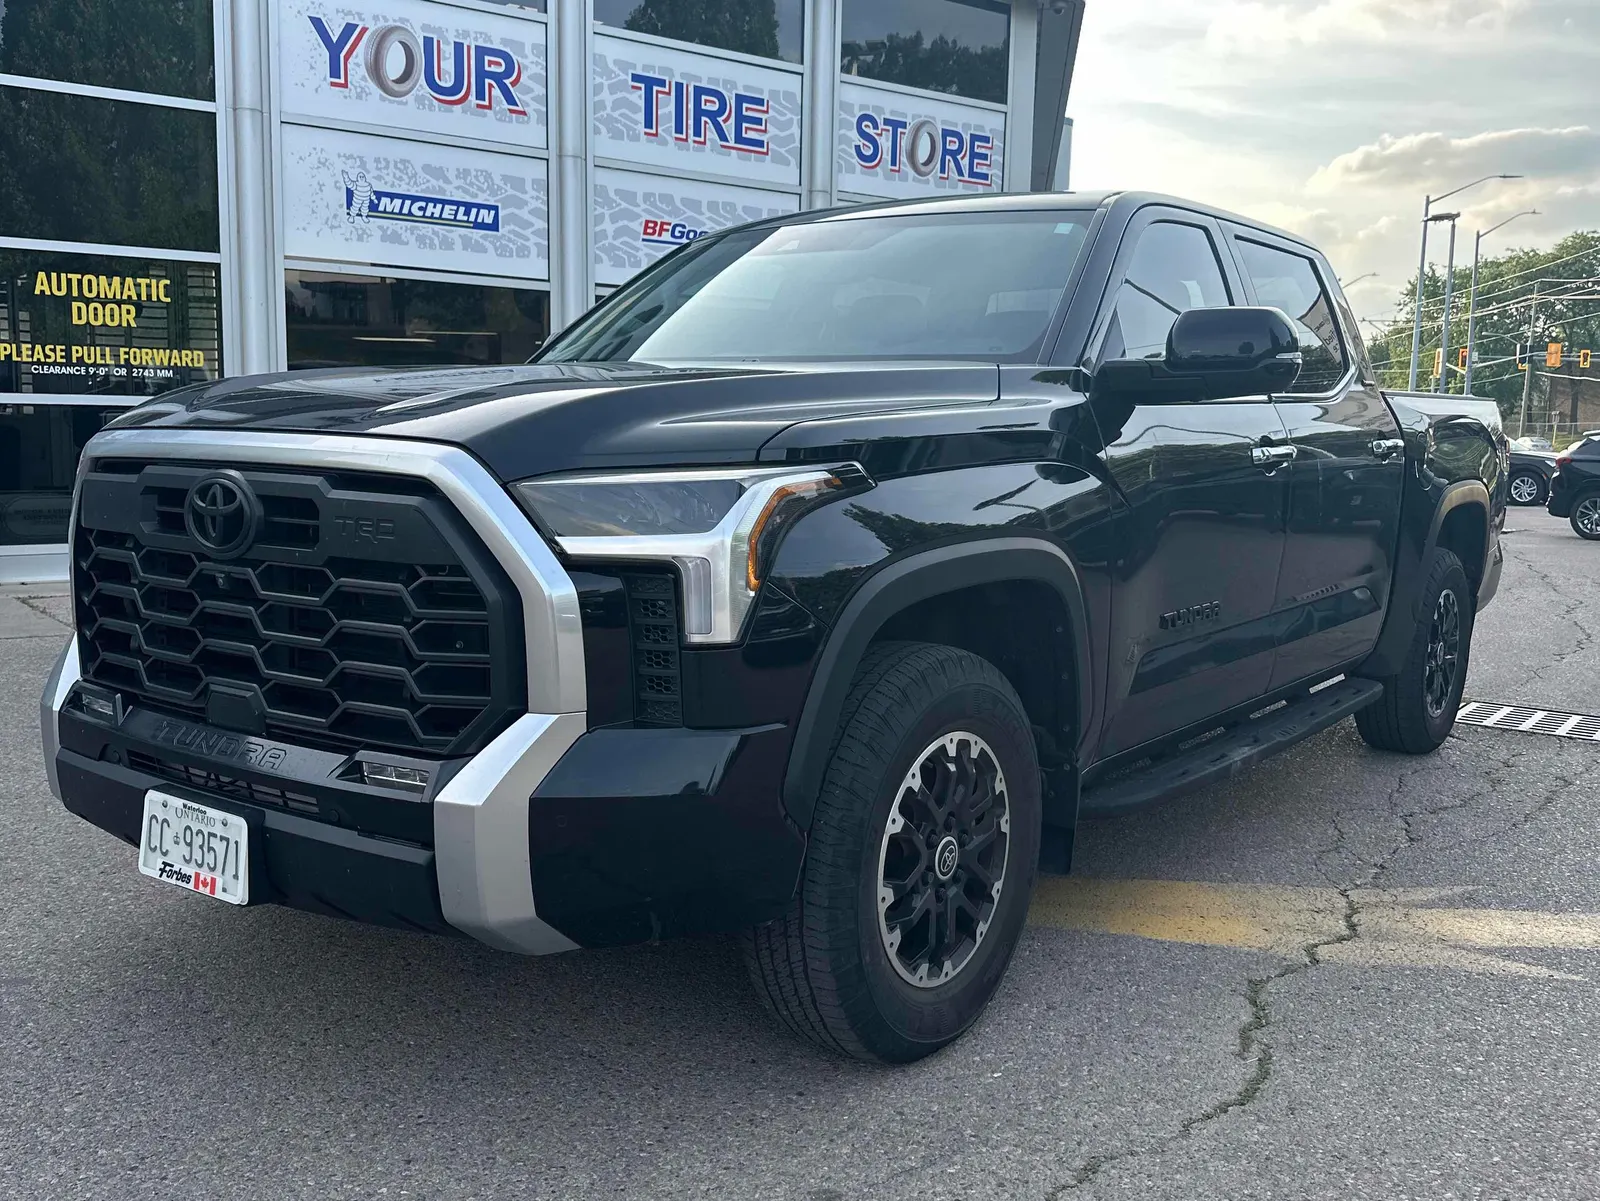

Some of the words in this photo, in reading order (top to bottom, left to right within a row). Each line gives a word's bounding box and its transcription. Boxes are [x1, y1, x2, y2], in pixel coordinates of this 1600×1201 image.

[307, 15, 527, 117] YOUR
[631, 72, 770, 156] TIRE
[854, 113, 993, 187] STORE
[378, 196, 496, 225] MICHELIN
[34, 271, 172, 303] AUTOMATIC
[71, 301, 137, 328] DOOR
[0, 342, 66, 363] PLEASE
[72, 345, 115, 365] PULL
[119, 346, 205, 368] FORWARD
[31, 364, 87, 375] CLEARANCE
[113, 367, 128, 377] OR
[132, 368, 154, 378] 2743
[156, 369, 174, 378] MM
[333, 515, 396, 544] TRD
[1159, 600, 1220, 630] TUNDRA
[156, 720, 288, 771] TUNDRA
[175, 807, 216, 827] ONTARIO
[182, 802, 208, 815] Waterloo
[148, 813, 171, 857] CC
[182, 824, 240, 881] 93571
[158, 860, 193, 885] Forbes
